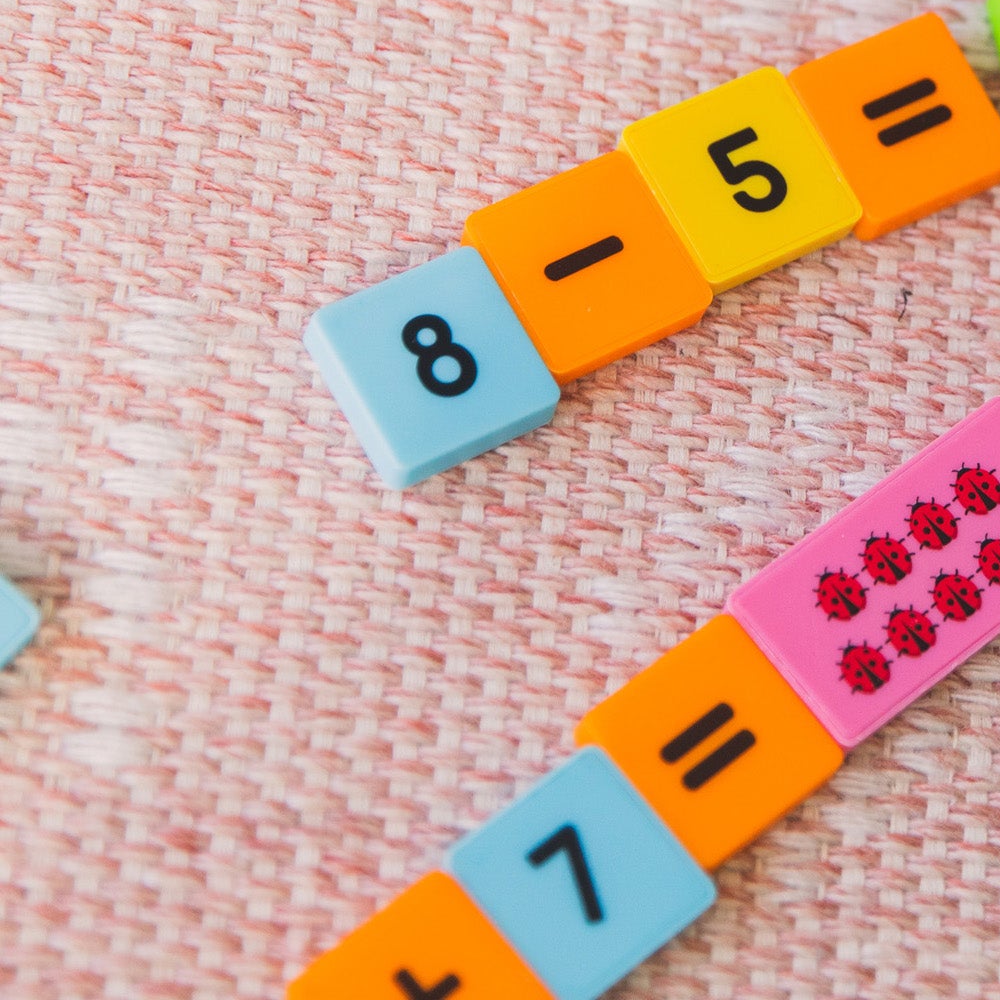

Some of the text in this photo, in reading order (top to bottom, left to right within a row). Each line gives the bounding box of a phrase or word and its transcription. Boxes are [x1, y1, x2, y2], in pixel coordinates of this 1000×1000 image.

[402, 314, 478, 397] 8
[707, 126, 788, 213] 5
[863, 78, 953, 147] =
[526, 823, 603, 924] 7
[661, 702, 756, 790] =
